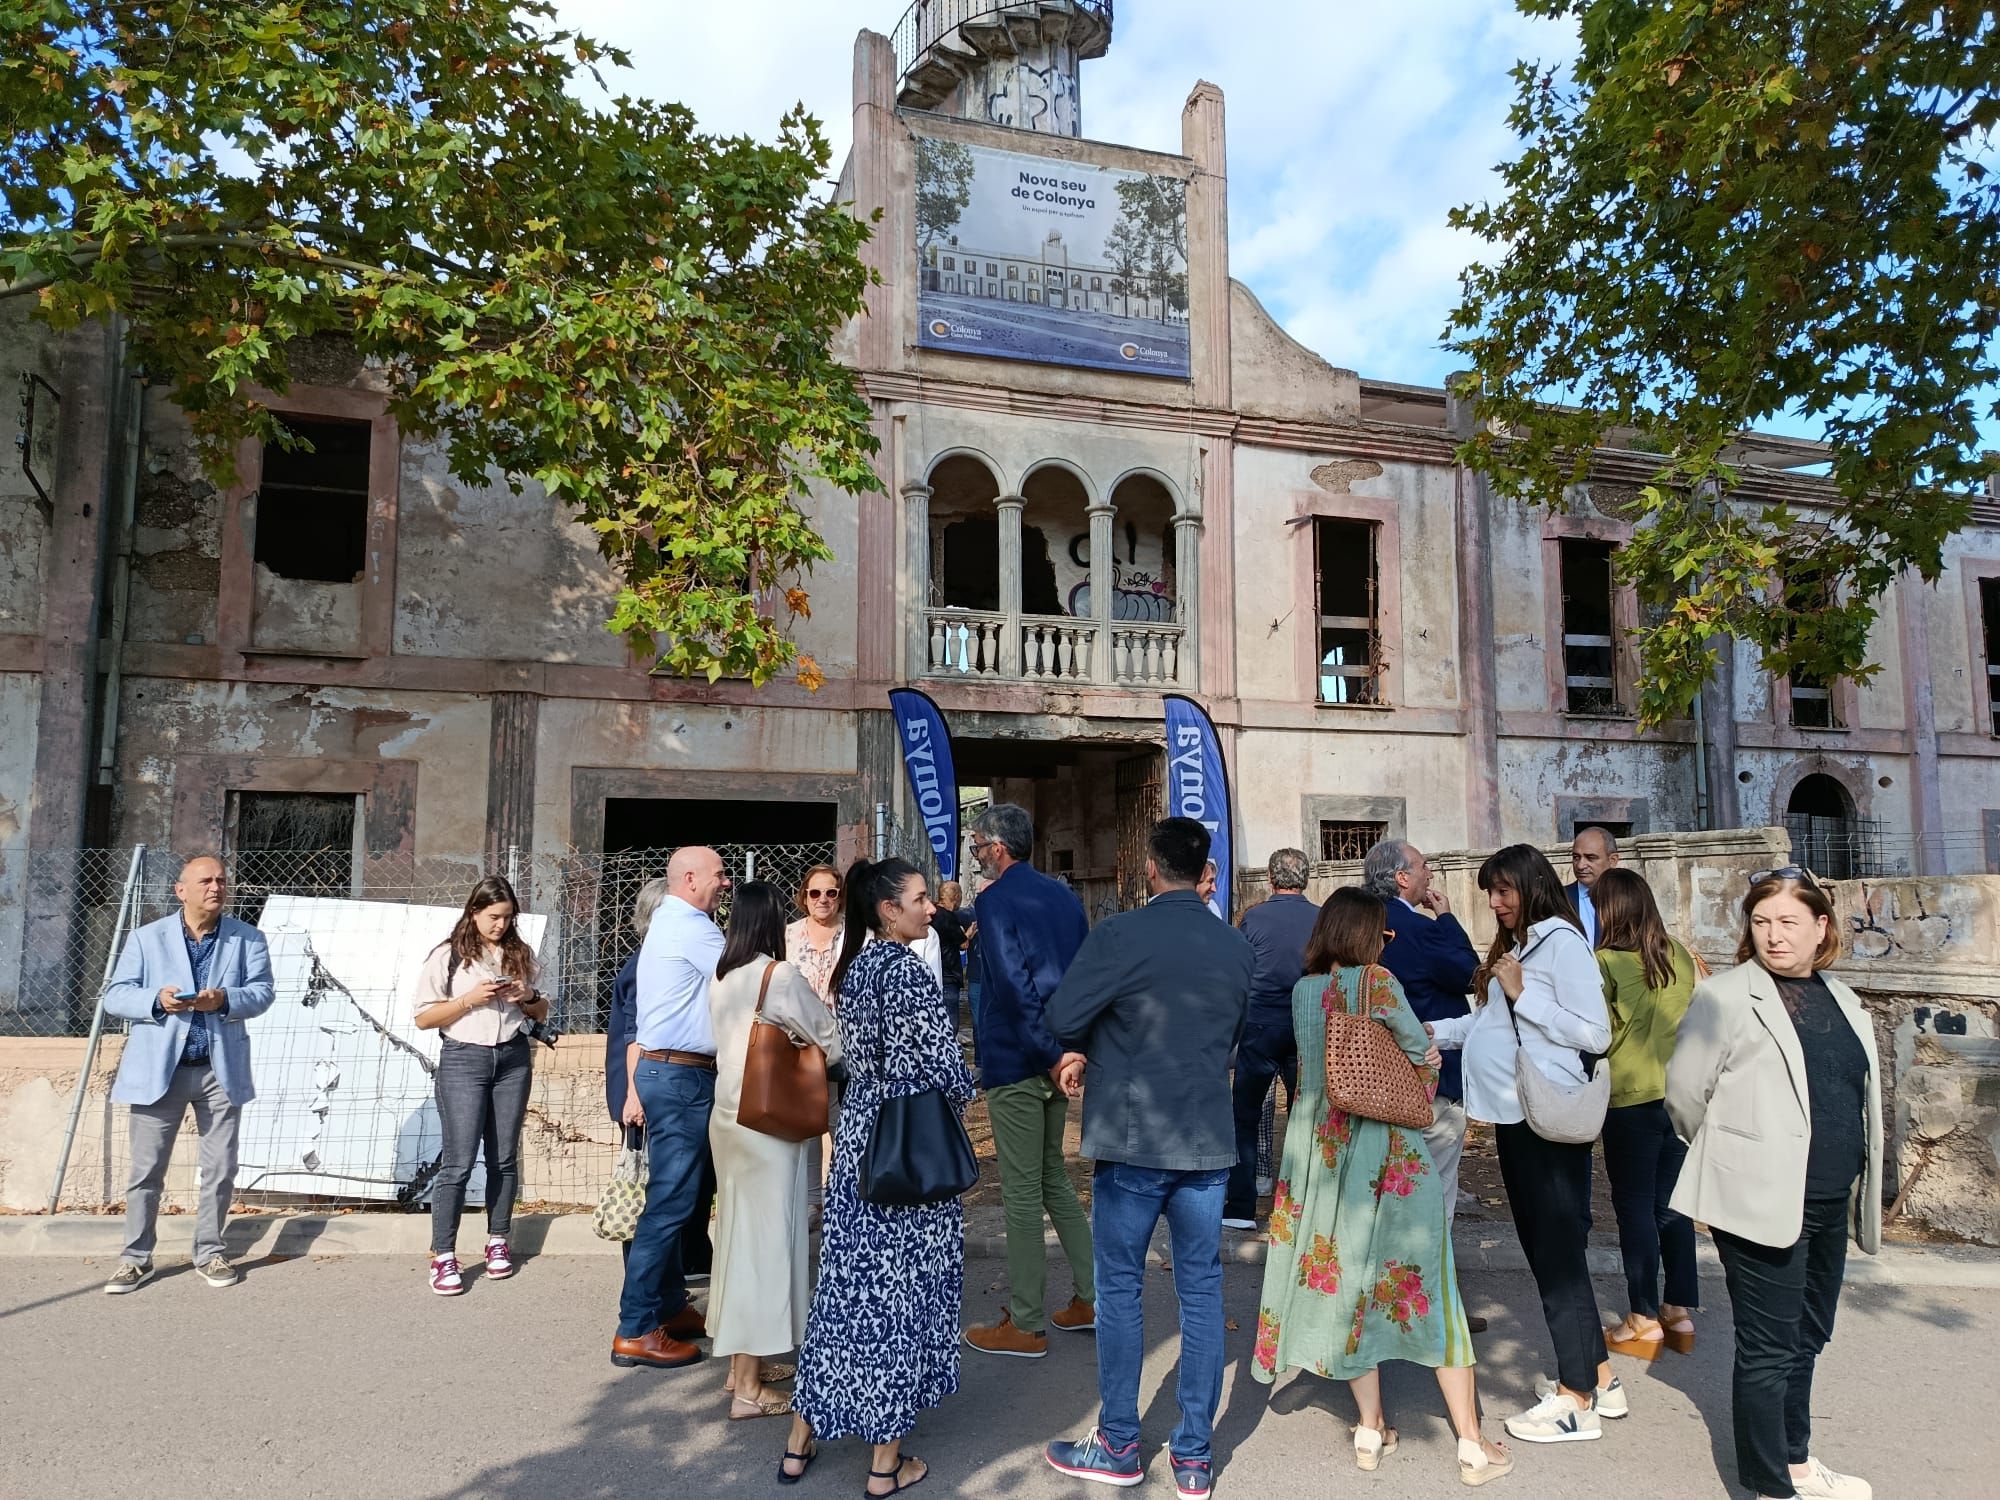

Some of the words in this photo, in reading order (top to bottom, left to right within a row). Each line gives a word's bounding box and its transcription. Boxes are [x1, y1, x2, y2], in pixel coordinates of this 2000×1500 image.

[1019, 171, 1058, 188] Nova
[1061, 180, 1087, 193] seu
[1011, 186, 1030, 199] de
[1033, 190, 1095, 210] Colonya
[951, 324, 982, 336] Colonya
[1140, 347, 1169, 358] Colonya
